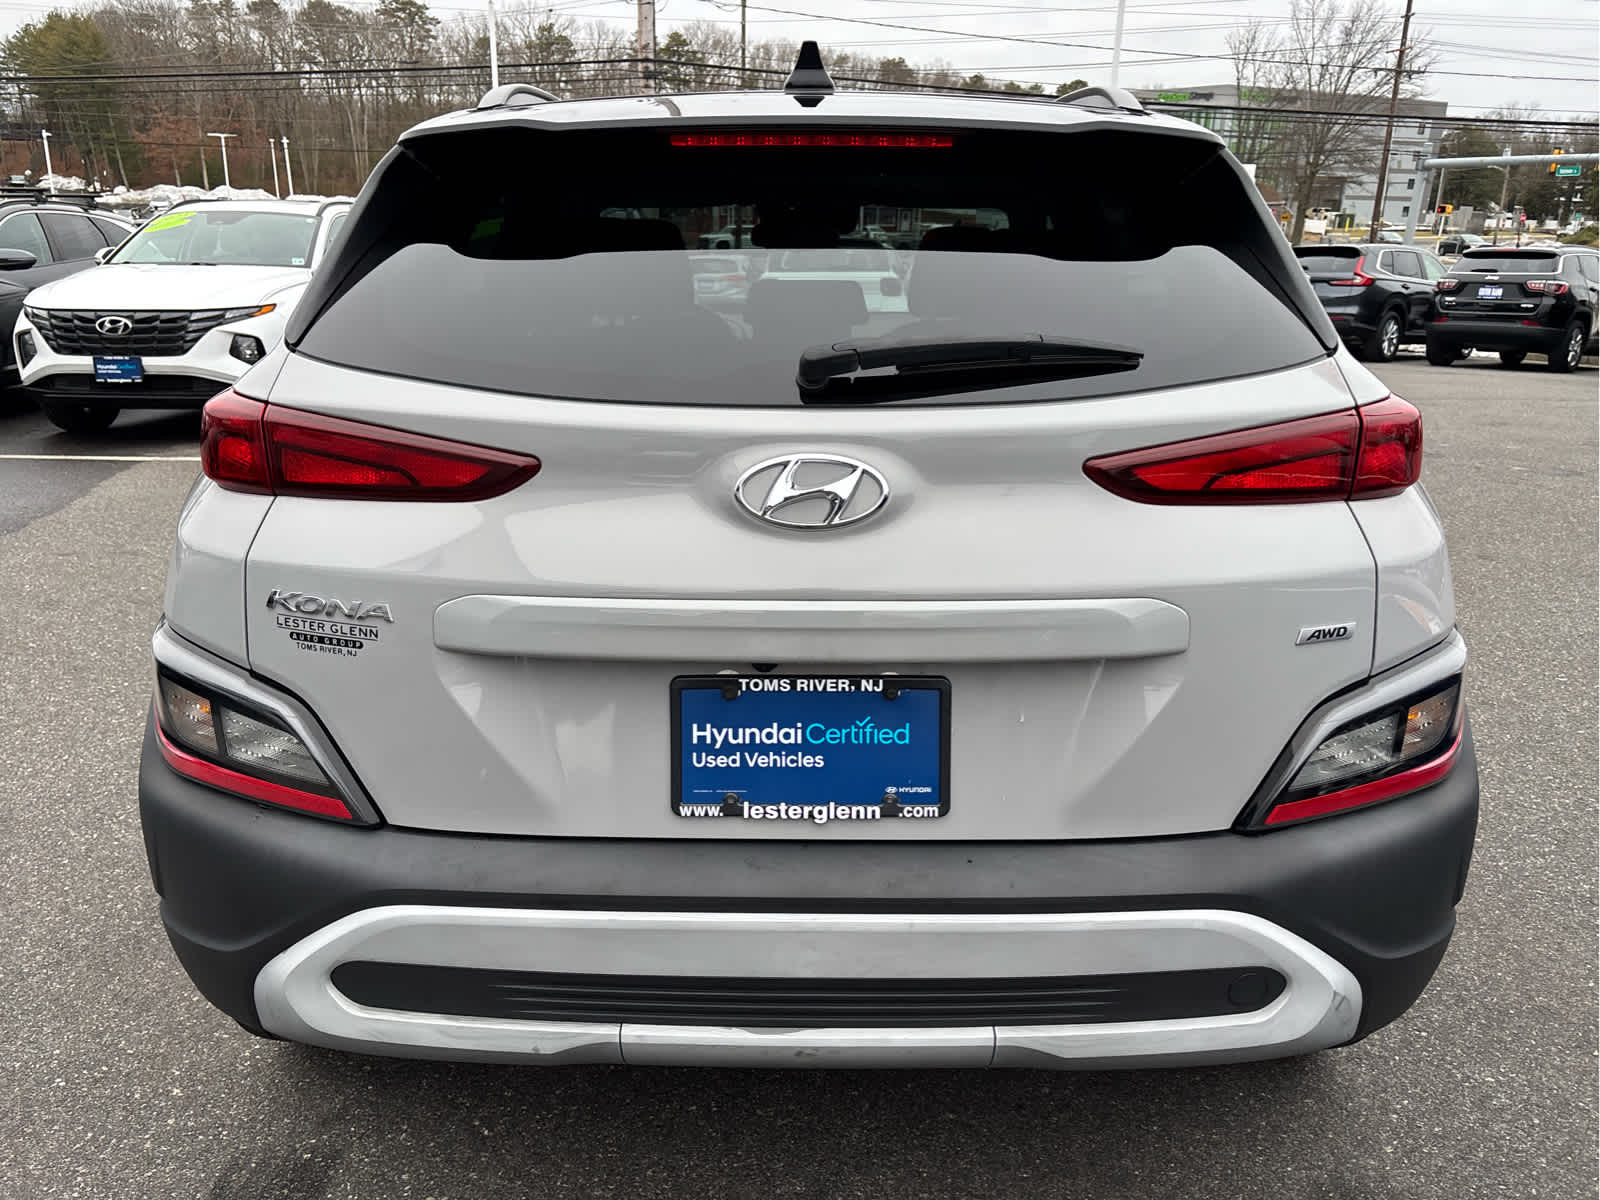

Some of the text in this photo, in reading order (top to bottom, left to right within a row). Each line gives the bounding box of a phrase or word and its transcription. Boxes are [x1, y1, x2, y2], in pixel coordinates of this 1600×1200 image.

[266, 589, 395, 623] KONA
[276, 615, 379, 639] LESTER GLENN
[1306, 626, 1348, 641] AWD
[292, 632, 361, 648] AUTO GROUP
[296, 641, 317, 652] TOMS
[739, 679, 884, 693] TOMS RIVER, NJ
[692, 716, 910, 749] Hyundai Certified
[692, 752, 825, 768] Used Vehicles
[679, 802, 939, 824] www. lesterglenn .com
